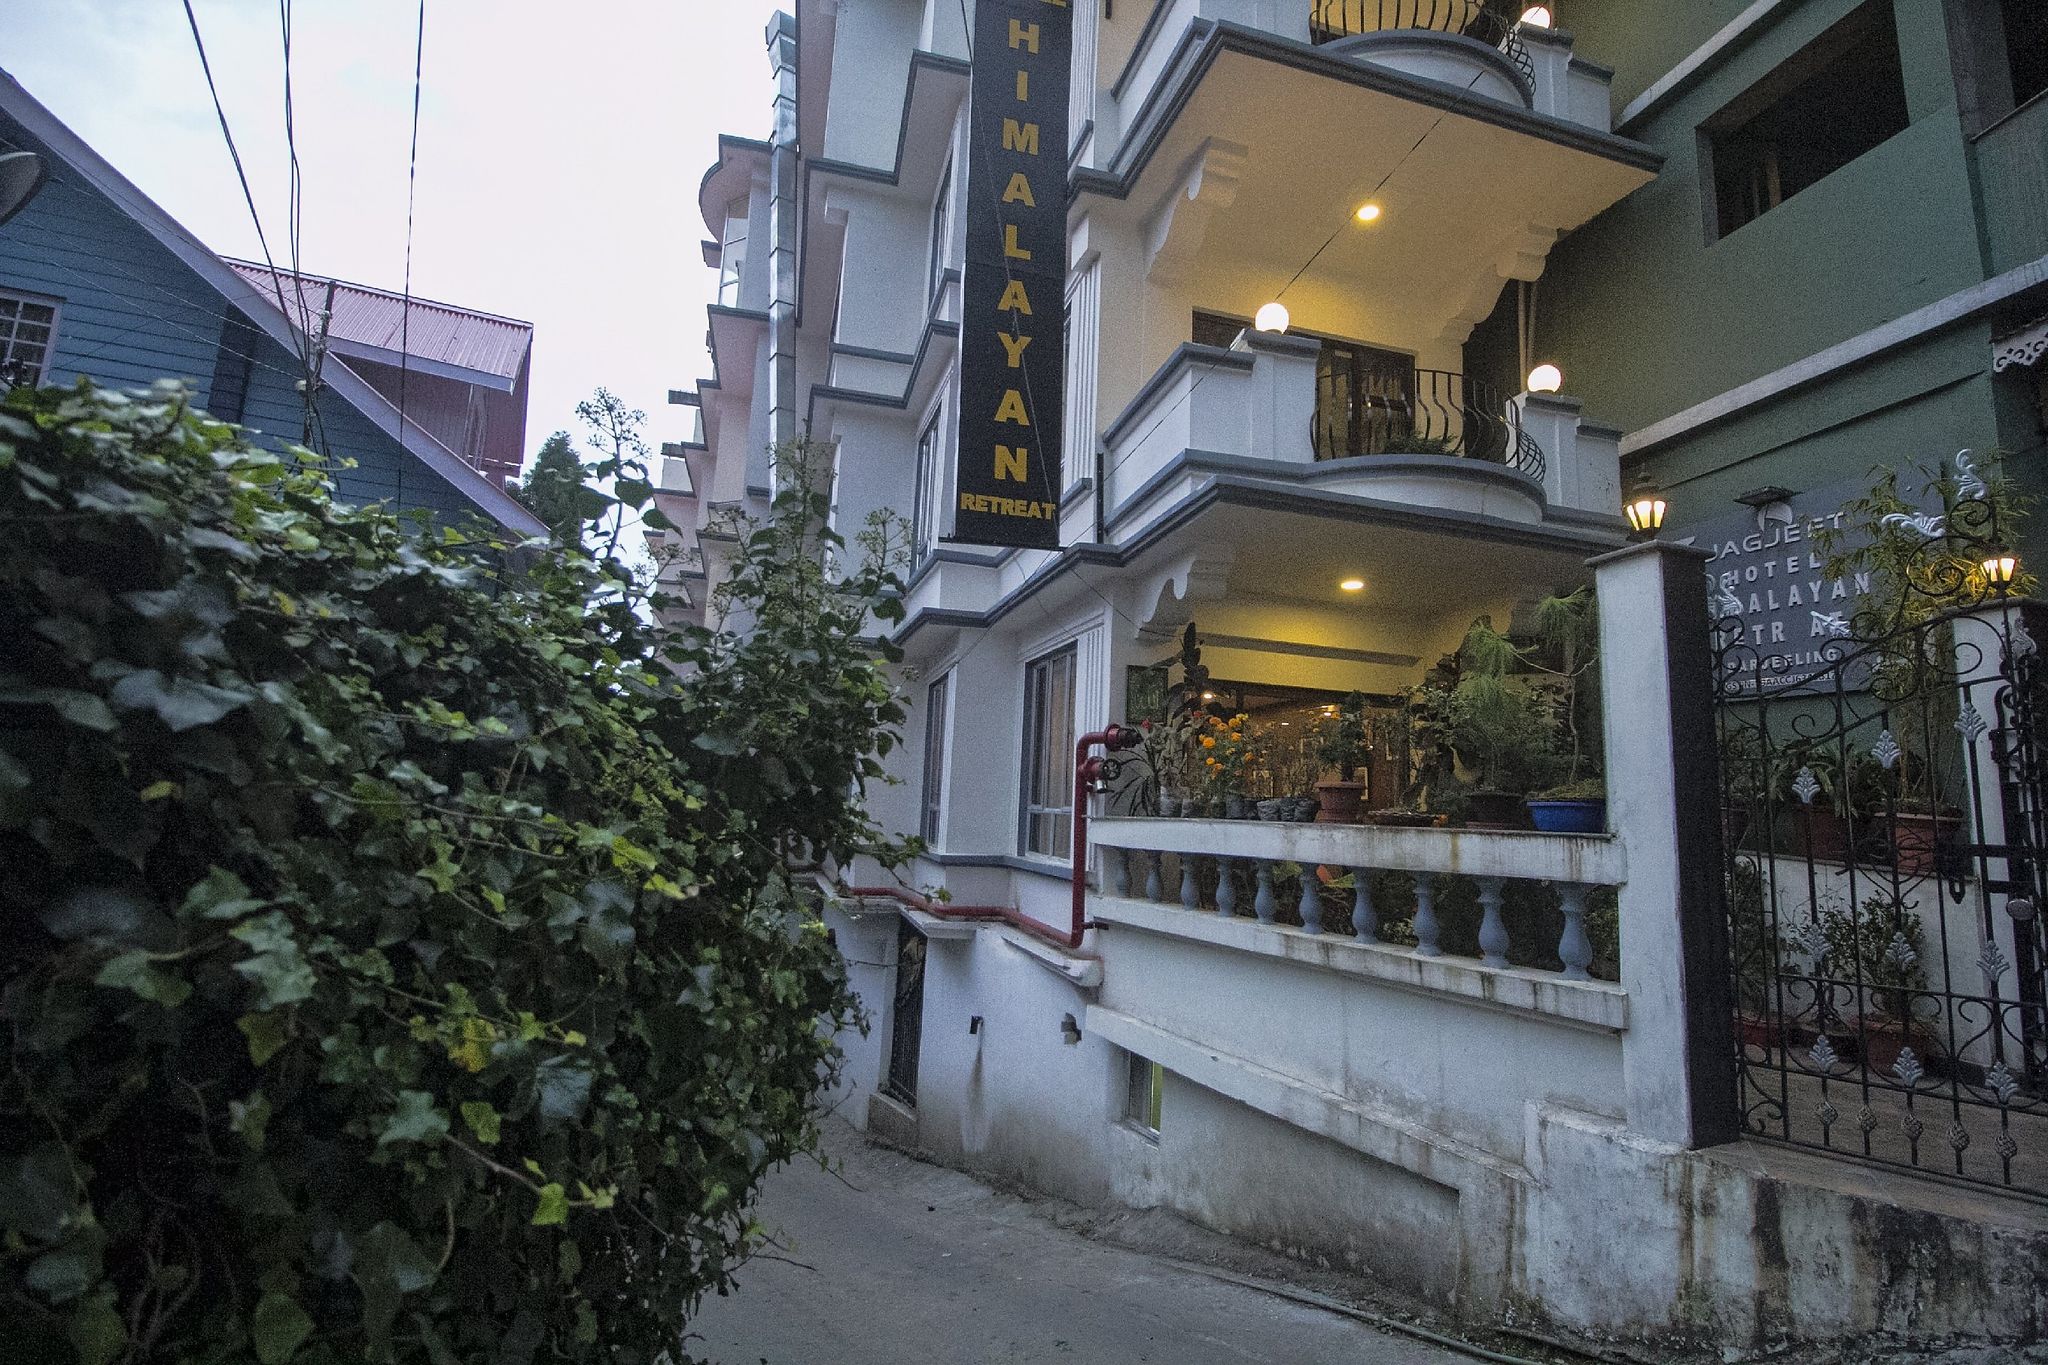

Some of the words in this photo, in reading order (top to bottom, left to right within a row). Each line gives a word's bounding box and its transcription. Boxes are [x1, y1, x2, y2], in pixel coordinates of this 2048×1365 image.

[993, 17, 1041, 483] HIMALAYAN
[960, 492, 1056, 520] RETREAT
[1704, 511, 1845, 563] JAGJEET
[1726, 551, 1822, 587] HOTEL
